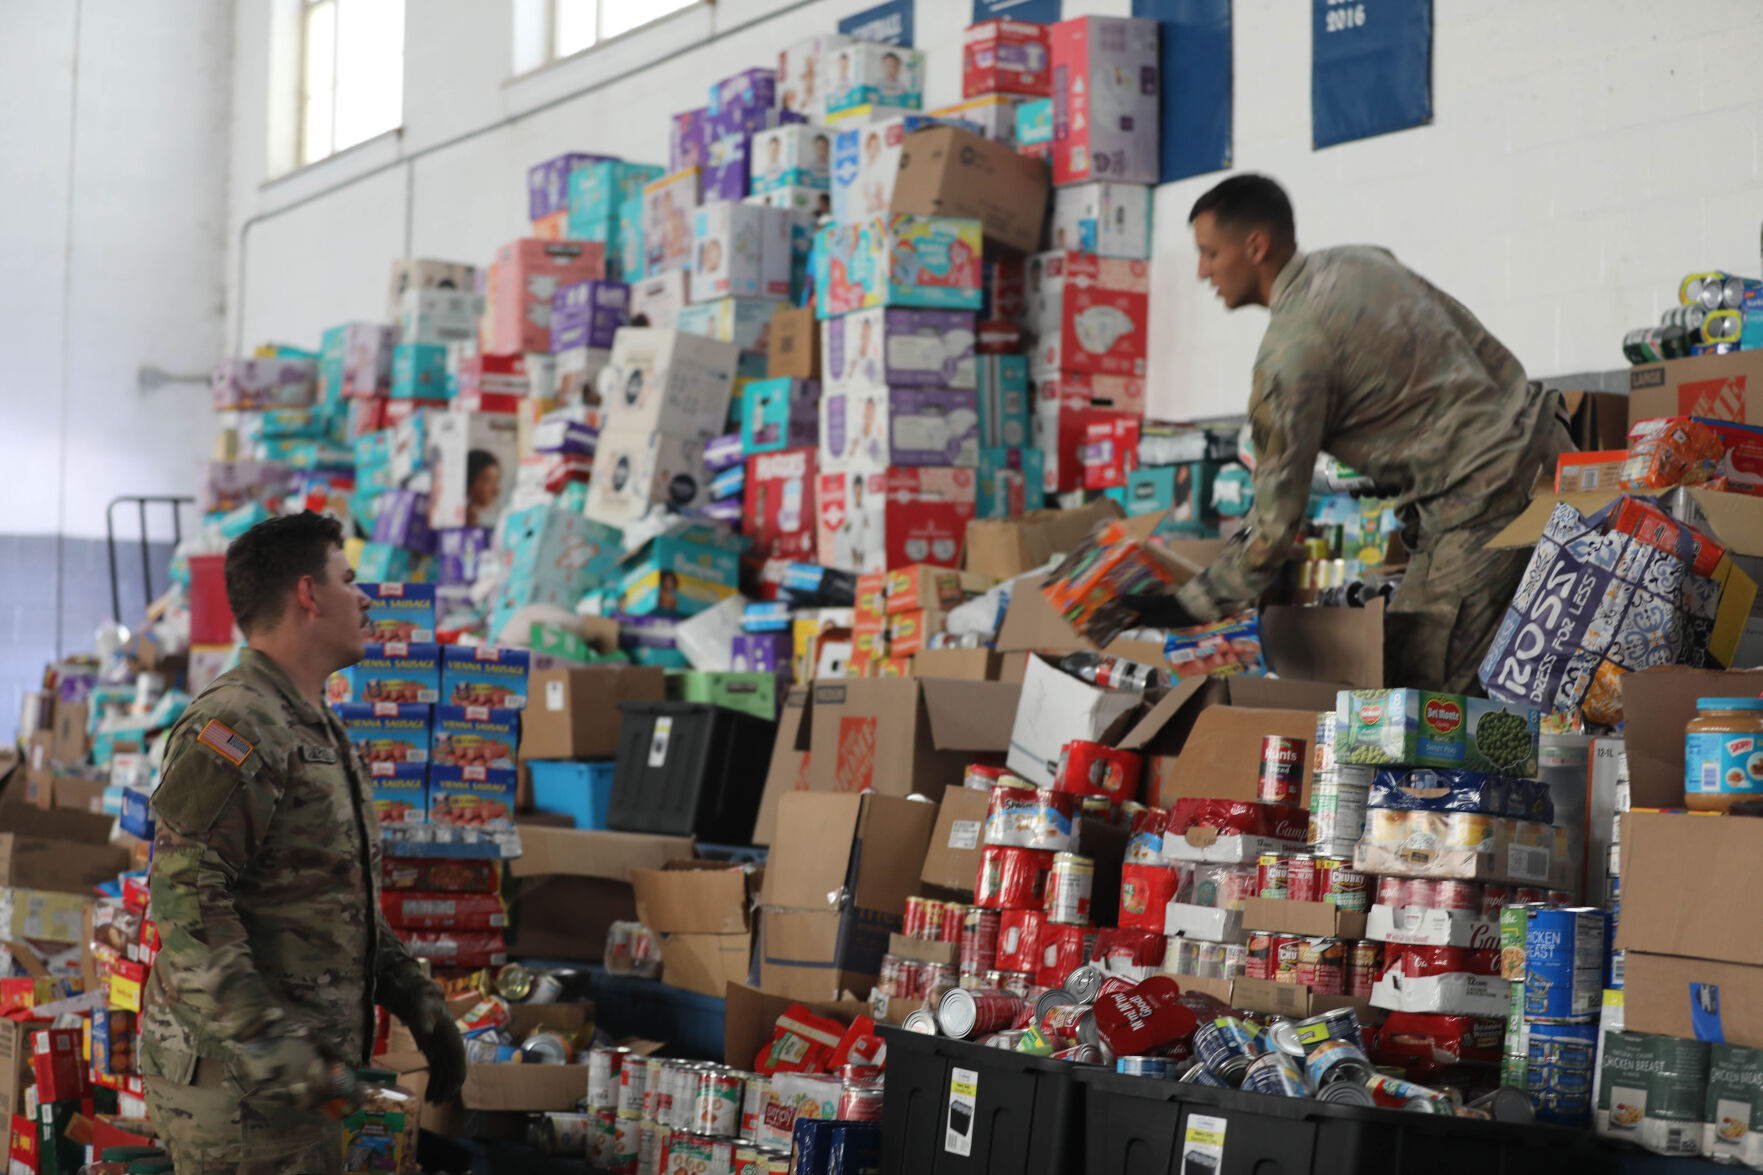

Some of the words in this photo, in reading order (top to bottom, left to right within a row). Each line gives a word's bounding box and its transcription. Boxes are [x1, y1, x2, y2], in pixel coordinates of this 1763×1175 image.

[1326, 4, 1366, 32] 2016
[1498, 560, 1577, 696] ROSS
[358, 659, 392, 668] VIENNA
[394, 659, 435, 669] SAUSAGE
[448, 661, 482, 671] VIENNA
[484, 664, 524, 675] SAUSAGE
[1530, 653, 1557, 702] DRESS
[1552, 620, 1576, 651] FOR
[1427, 707, 1440, 720] Del
[1440, 709, 1460, 722] Monte
[385, 719, 425, 729] SAUSAGE
[475, 722, 510, 733] SAUSAGE
[472, 782, 507, 793] SAUSAGE
[1269, 868, 1288, 879] CHU
[1332, 870, 1365, 884] CHUNKY
[1526, 931, 1561, 945] HICKEN
[1280, 950, 1298, 960] CHU
[1526, 945, 1556, 959] EAST
[1129, 995, 1152, 1018] Good!
[1602, 1055, 1635, 1070] CHICKEN
[1636, 1060, 1666, 1073] BREAST
[1711, 1067, 1739, 1082] CHICKEN
[1740, 1071, 1763, 1086] BREAS
